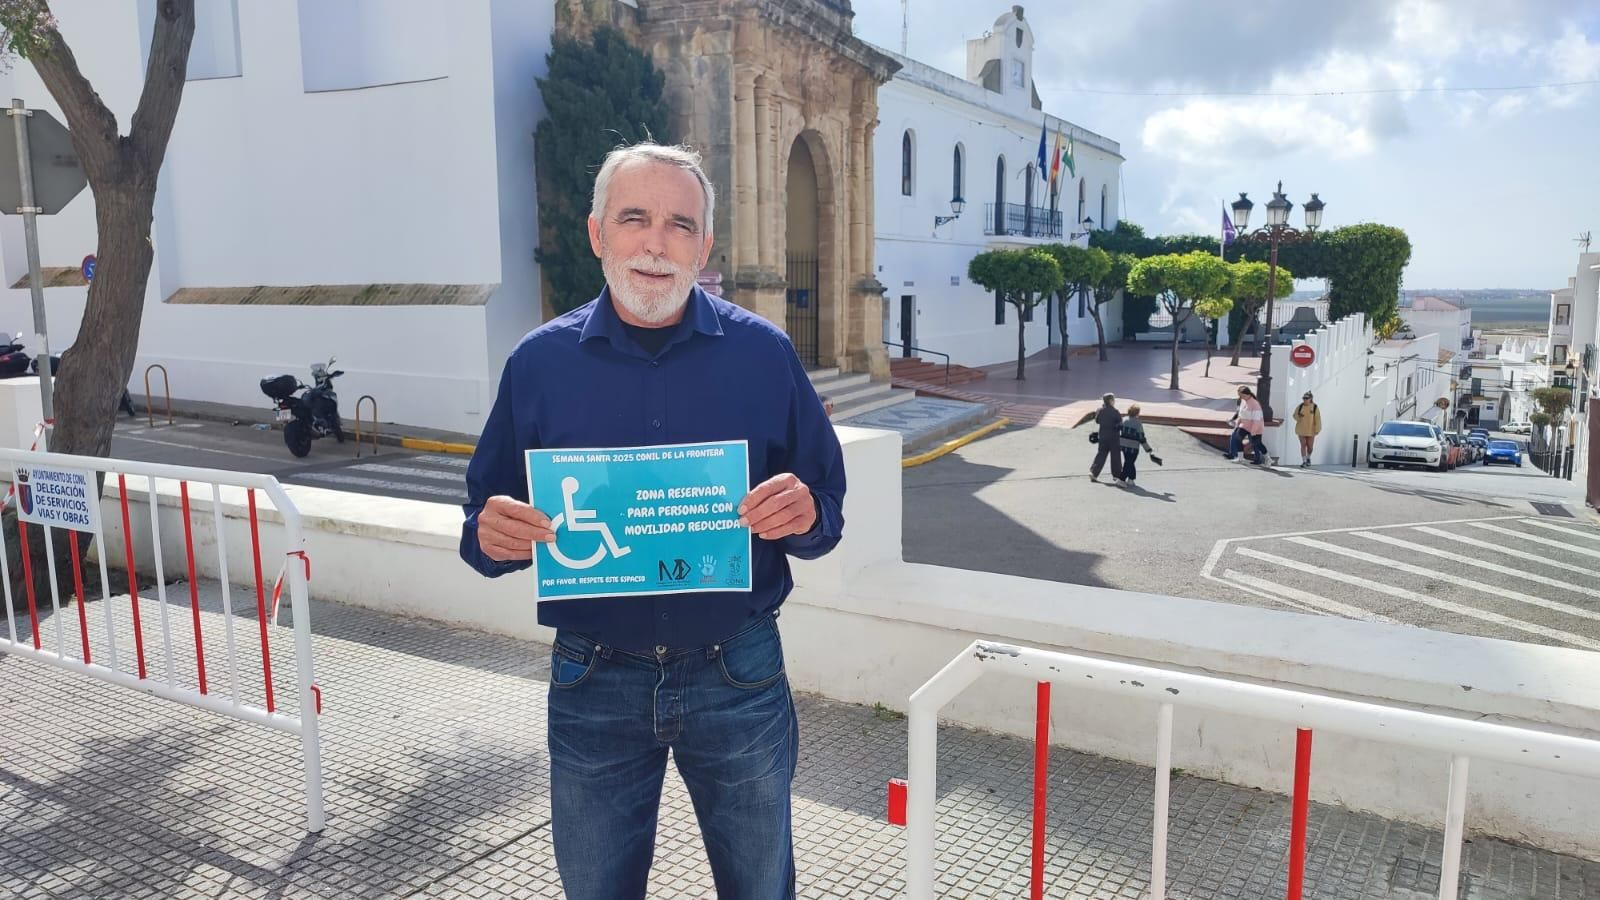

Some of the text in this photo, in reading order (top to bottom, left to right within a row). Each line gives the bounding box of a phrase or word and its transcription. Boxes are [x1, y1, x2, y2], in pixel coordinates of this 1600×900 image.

[552, 448, 725, 463] SEMANA SANTA 2025 CONIL DE LA FRONTERA
[36, 482, 85, 498] DELEGACIÓN
[635, 485, 727, 501] ZONA RESERVADA
[36, 495, 89, 513] DE SERVICIOS,
[627, 502, 734, 518] PARA PERSONAS CON
[38, 507, 89, 525] VIAS Y OBRAS
[624, 519, 741, 536] MOVILIDAD REDUCIDA
[541, 579, 555, 588] POR
[579, 576, 604, 585] RESPETE
[605, 575, 619, 584] ESTE
[620, 575, 646, 583] ESPACIO
